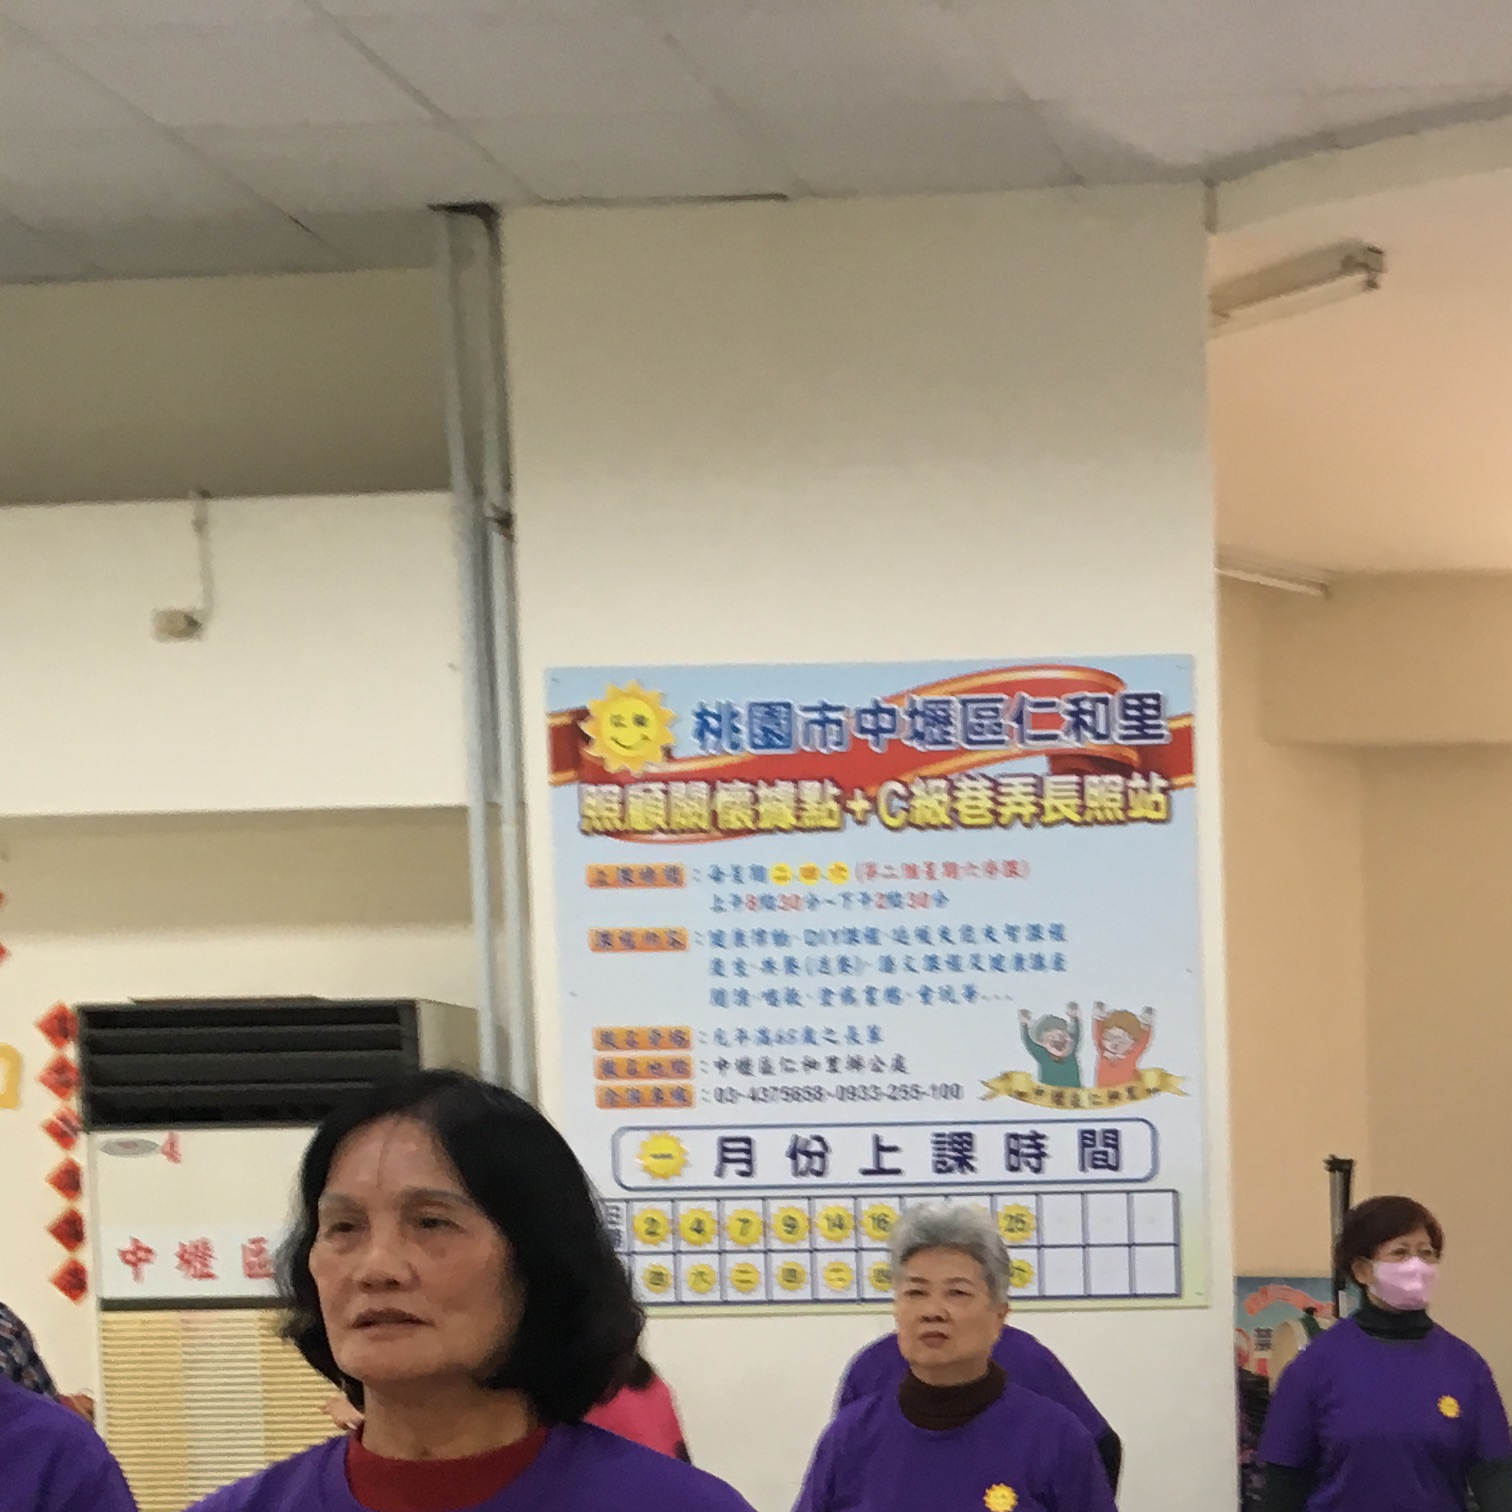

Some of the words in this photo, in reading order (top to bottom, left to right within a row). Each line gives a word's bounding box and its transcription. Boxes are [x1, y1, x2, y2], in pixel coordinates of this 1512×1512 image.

[692, 690, 1172, 754] 桃園市中壢區仁和里
[579, 773, 1172, 835] 照顧關懷據點+C級巷弄長照站
[714, 1128, 1122, 1178] 月份上課時間
[643, 1217, 658, 1236] 2
[736, 1216, 750, 1236] 7
